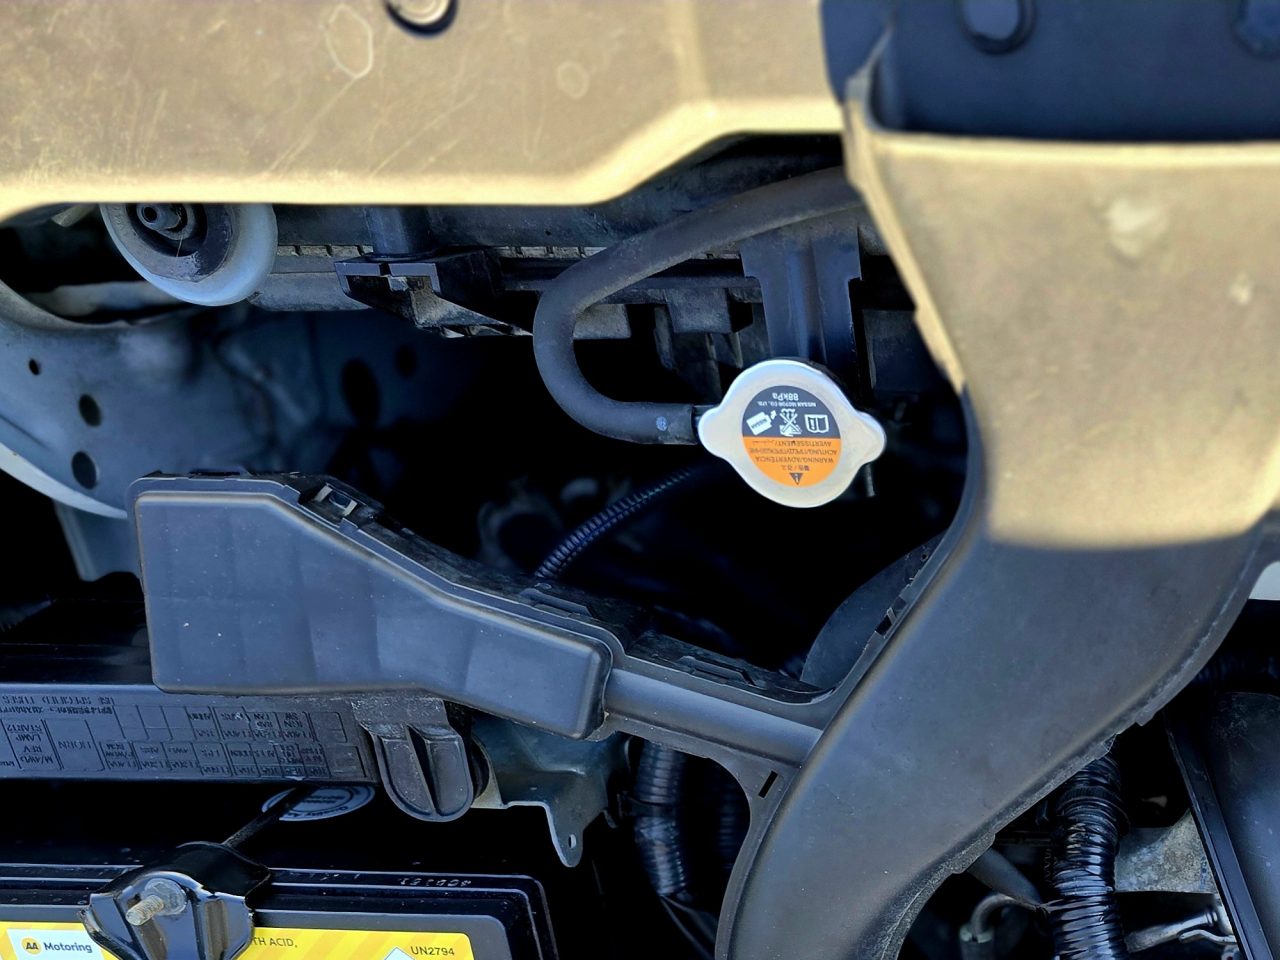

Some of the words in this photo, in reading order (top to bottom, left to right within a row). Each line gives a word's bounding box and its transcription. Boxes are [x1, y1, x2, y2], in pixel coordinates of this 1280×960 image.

[25, 942, 38, 950] AA
[43, 942, 93, 953] Motoring
[410, 946, 455, 956] UN2794
